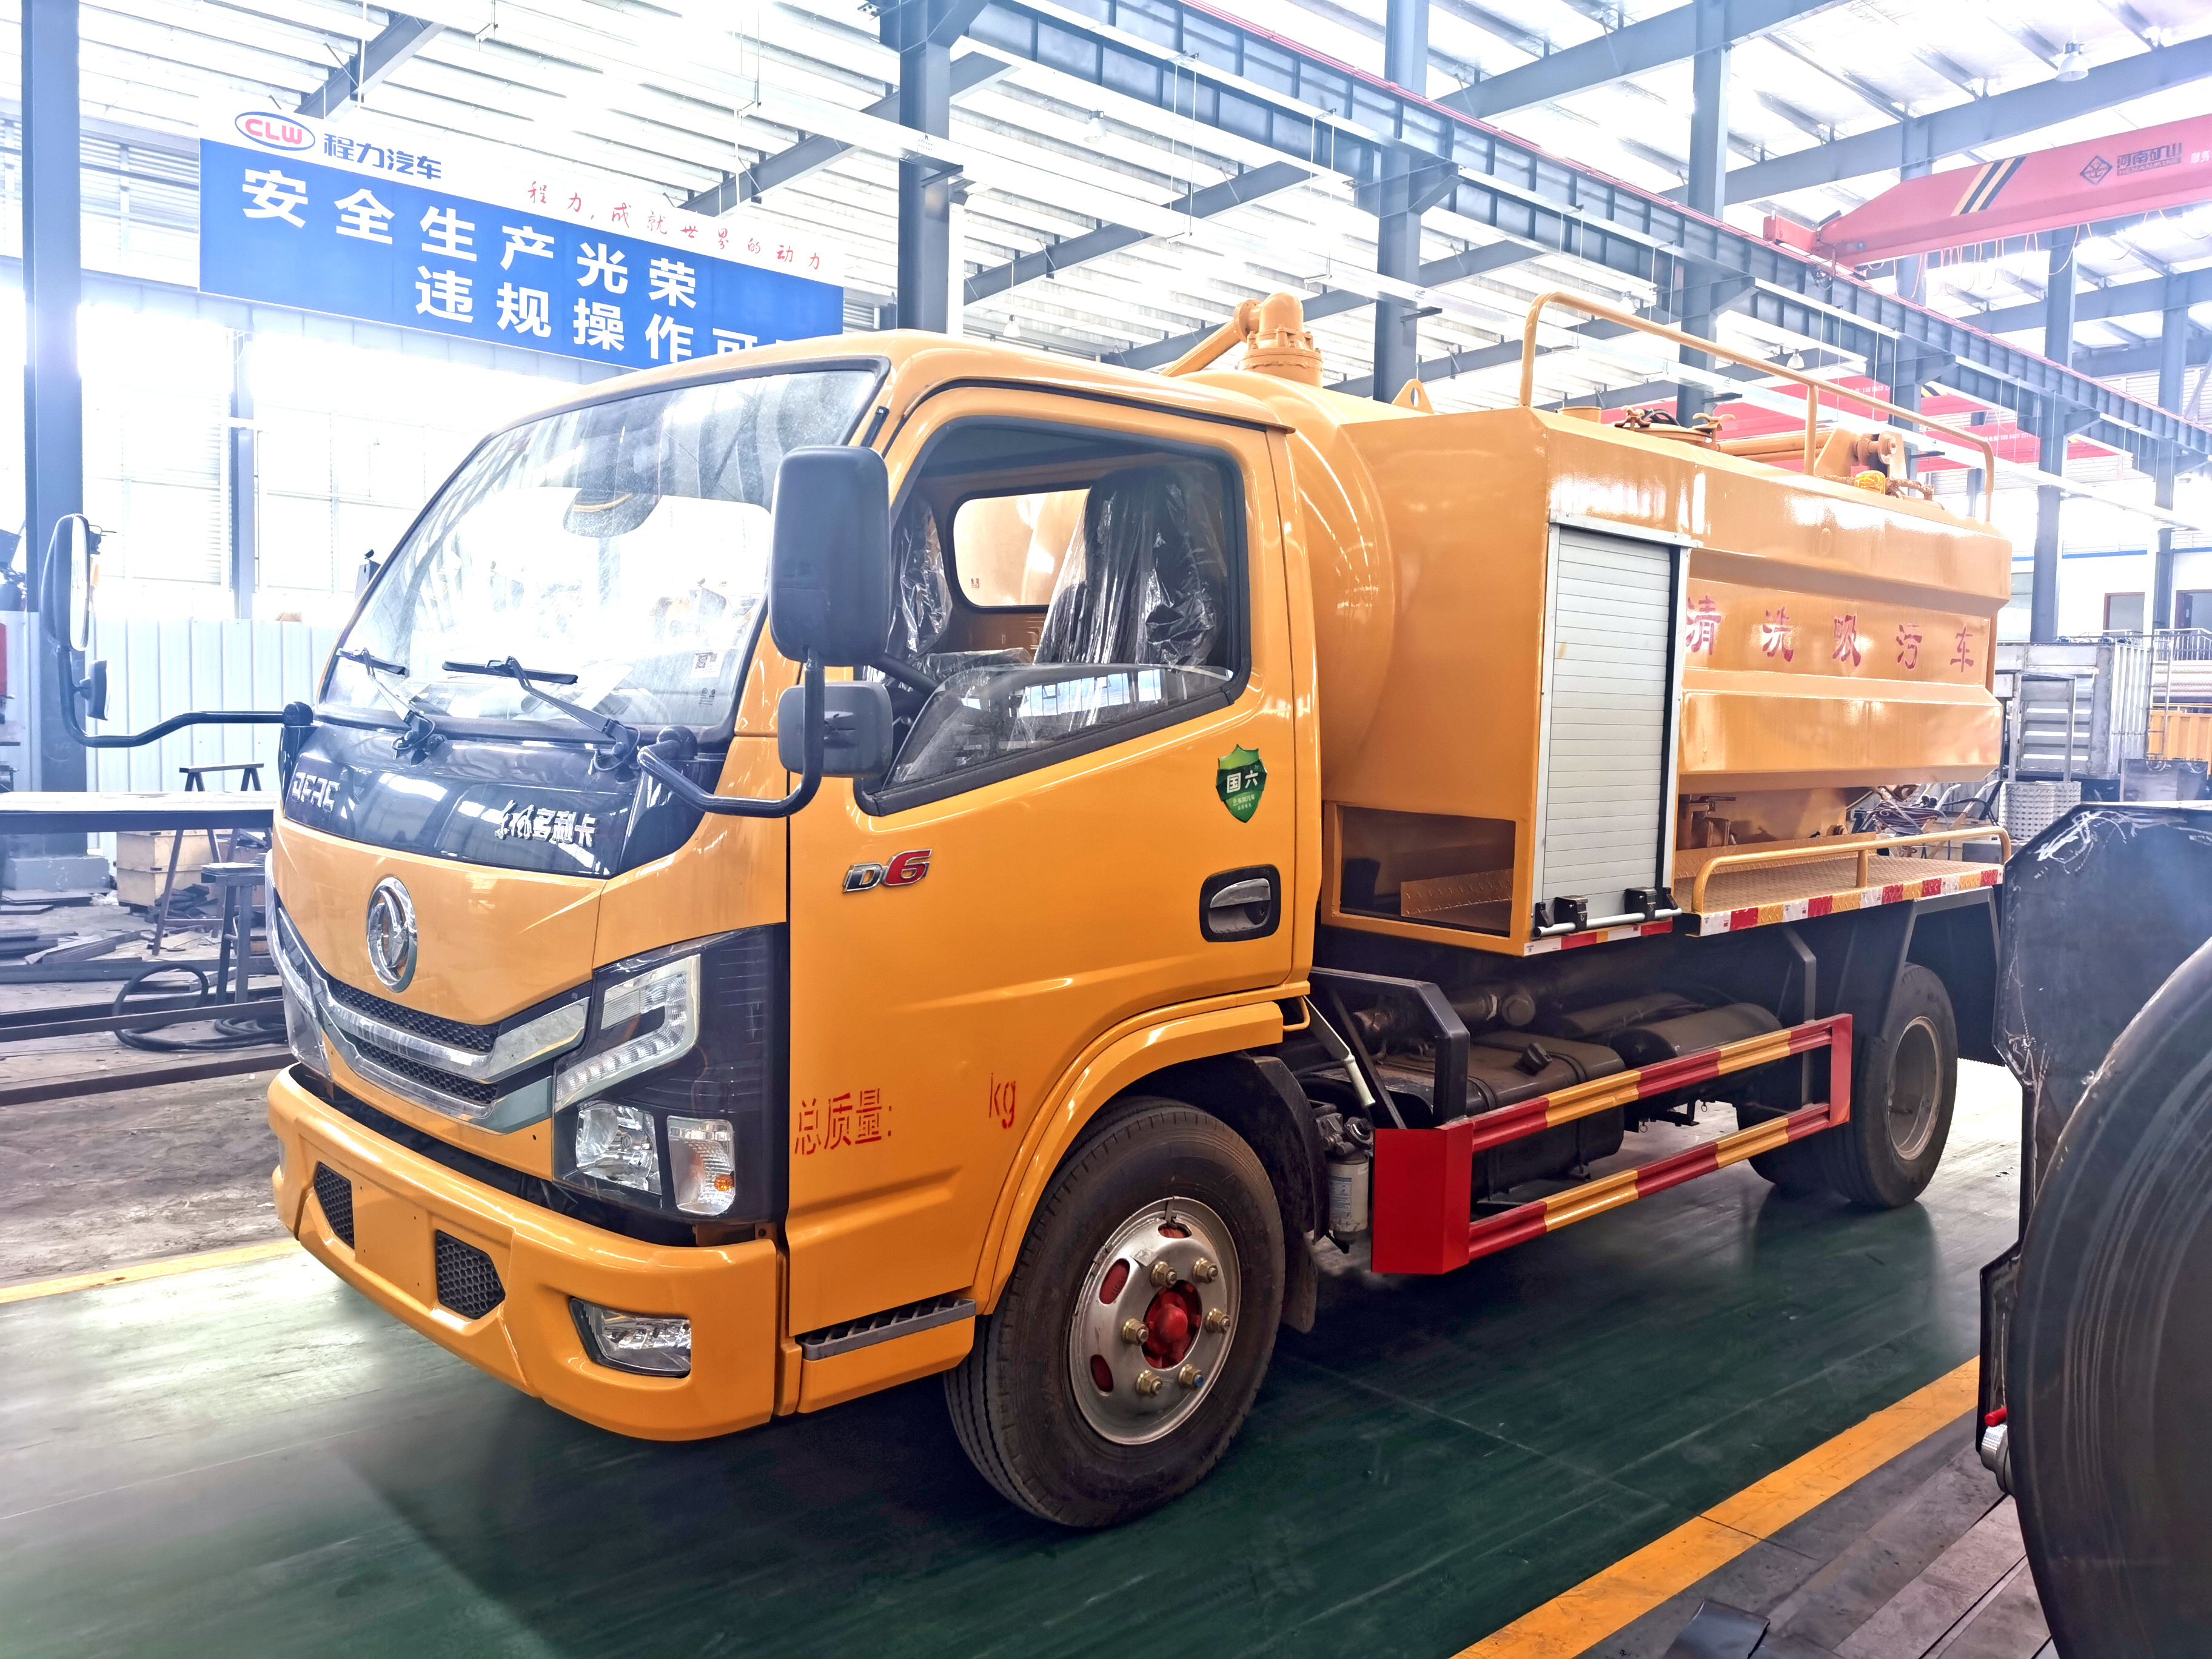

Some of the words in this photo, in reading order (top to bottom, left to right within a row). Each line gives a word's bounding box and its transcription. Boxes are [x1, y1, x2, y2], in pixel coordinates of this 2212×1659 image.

[244, 118, 303, 145] CLW
[324, 133, 441, 179] 程力汽车
[243, 169, 697, 309] 安全生产光荣
[1685, 595, 1974, 673] 清洗吸污车
[1227, 769, 1259, 794] 国六
[843, 848, 933, 893] D6
[988, 1073, 1017, 1129] kg
